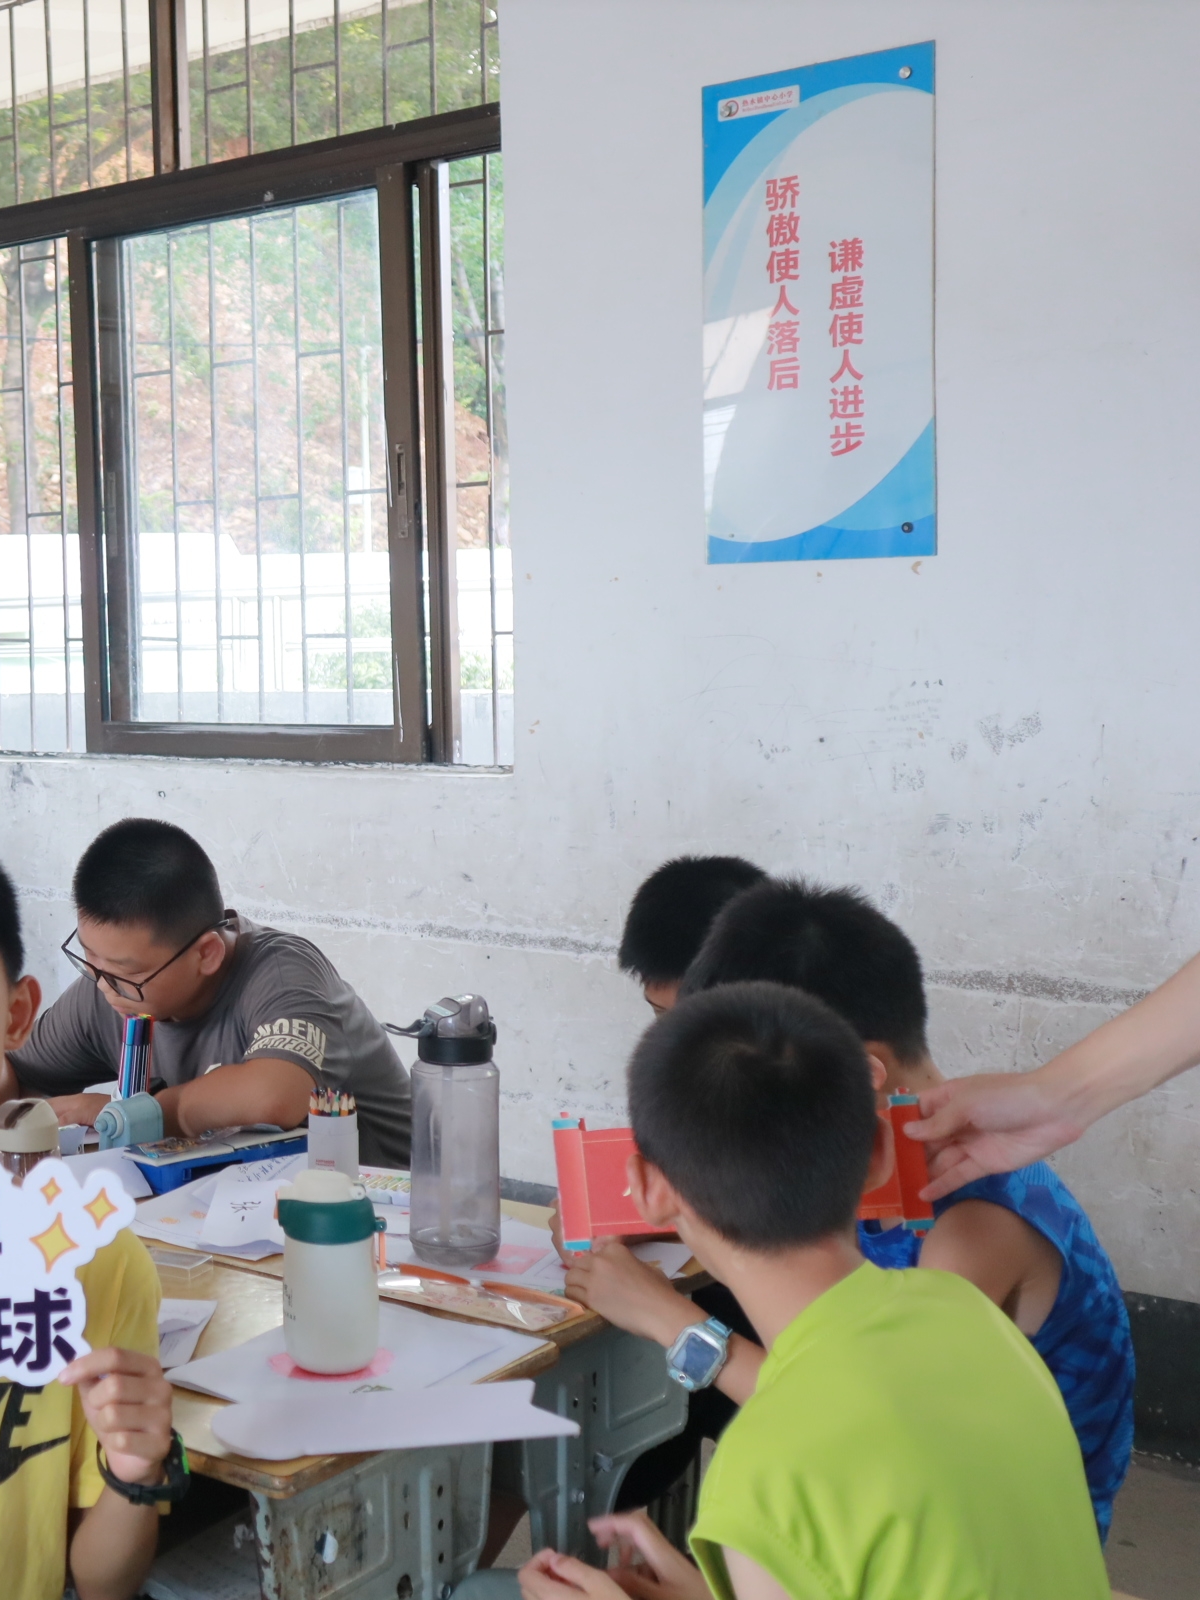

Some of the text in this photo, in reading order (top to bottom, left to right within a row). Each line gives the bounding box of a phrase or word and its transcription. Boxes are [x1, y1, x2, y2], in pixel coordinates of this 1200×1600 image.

[764, 174, 801, 392] 骄傲使人落后
[828, 237, 866, 458] 谦虚使人进步
